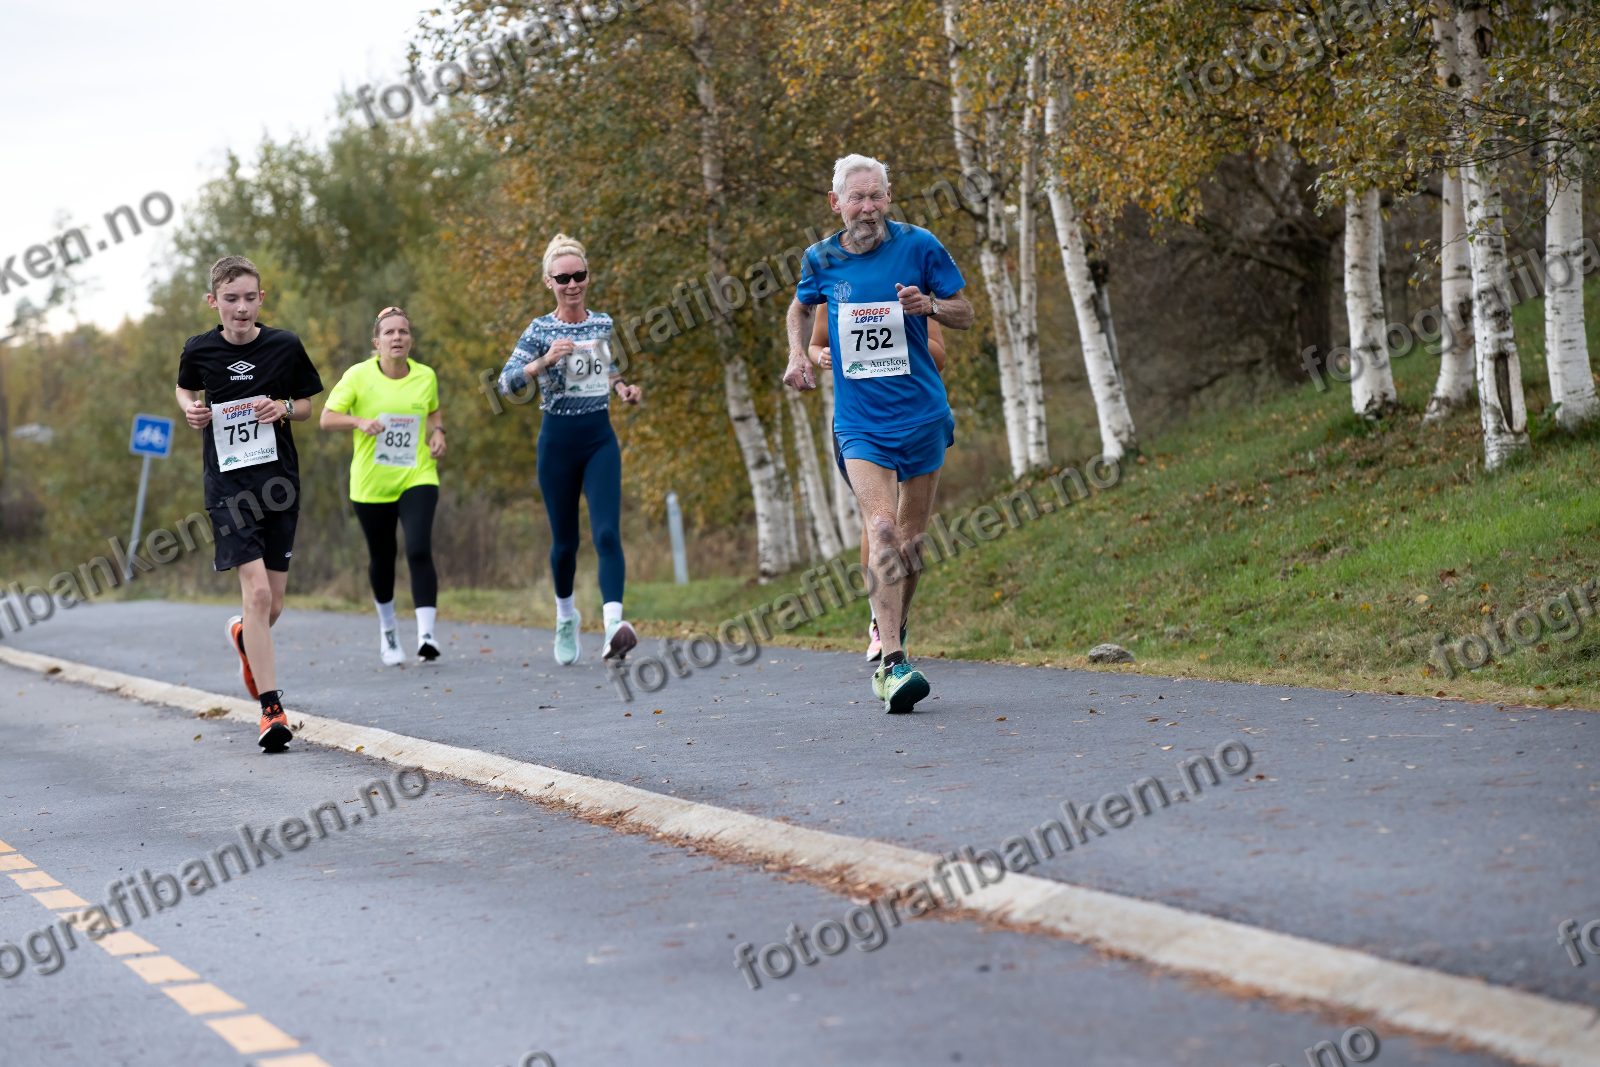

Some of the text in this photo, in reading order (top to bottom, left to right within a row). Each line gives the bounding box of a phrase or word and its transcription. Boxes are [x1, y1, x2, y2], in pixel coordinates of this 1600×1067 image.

[850, 307, 891, 317] NORGES
[855, 315, 885, 324] LØPET
[851, 327, 894, 352] 752
[576, 358, 602, 375] 216
[226, 408, 253, 421] LØPET
[223, 420, 261, 446] 757
[385, 430, 411, 448] 832
